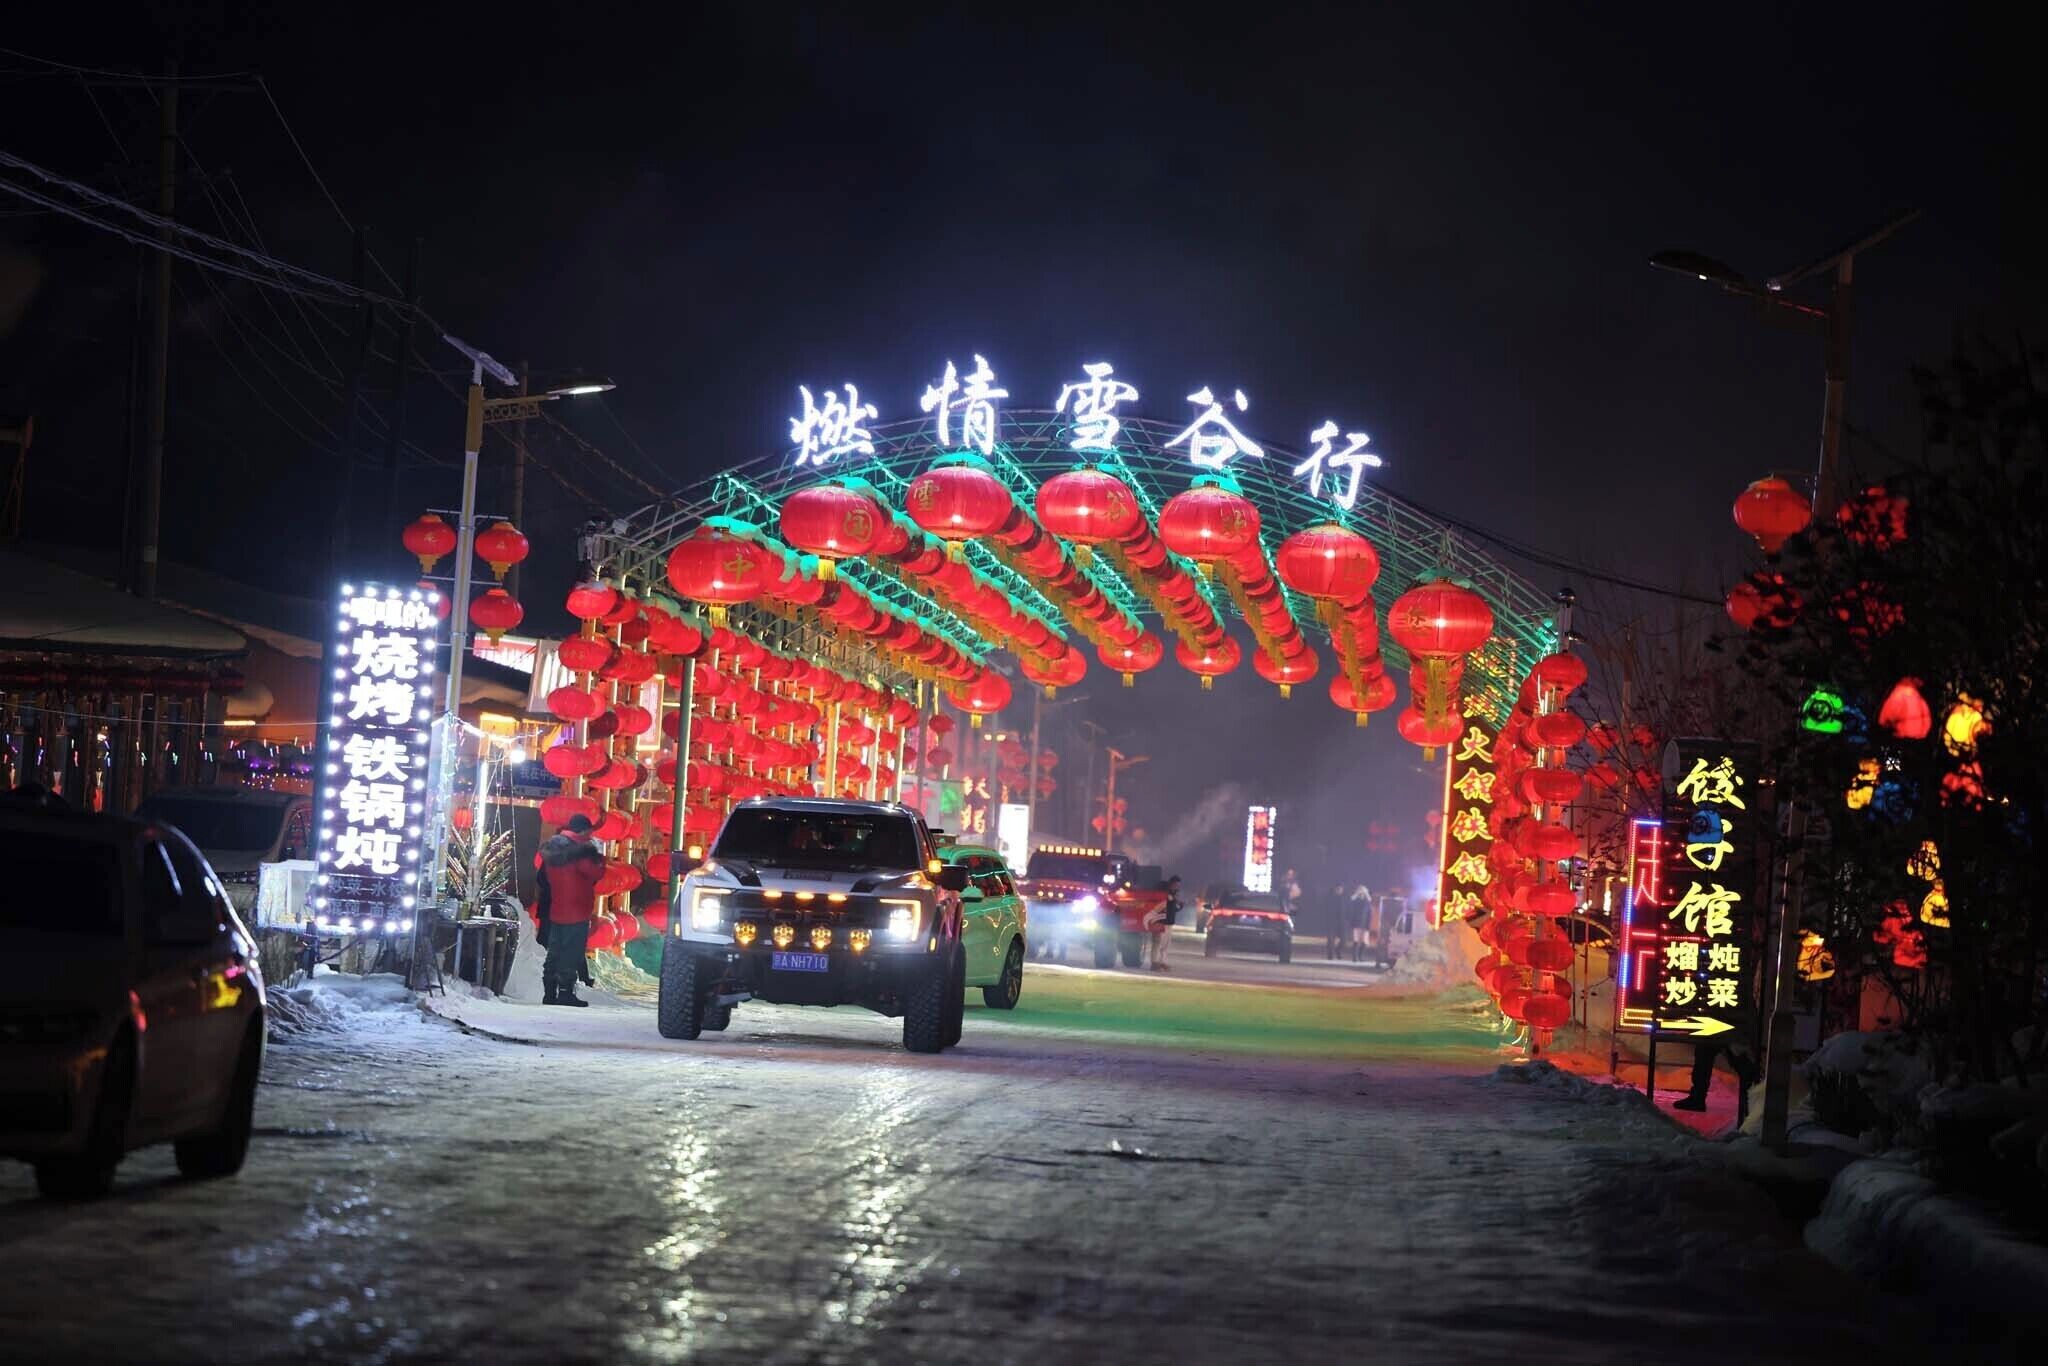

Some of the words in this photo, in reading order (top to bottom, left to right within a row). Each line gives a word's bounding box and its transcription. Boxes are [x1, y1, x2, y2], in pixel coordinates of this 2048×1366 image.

[790, 354, 1381, 511] 燃情雪谷行
[723, 553, 754, 582] 中
[347, 630, 419, 725] 烧烤
[334, 733, 409, 874] 铁锅炖
[1668, 756, 1745, 938] 饺子馆
